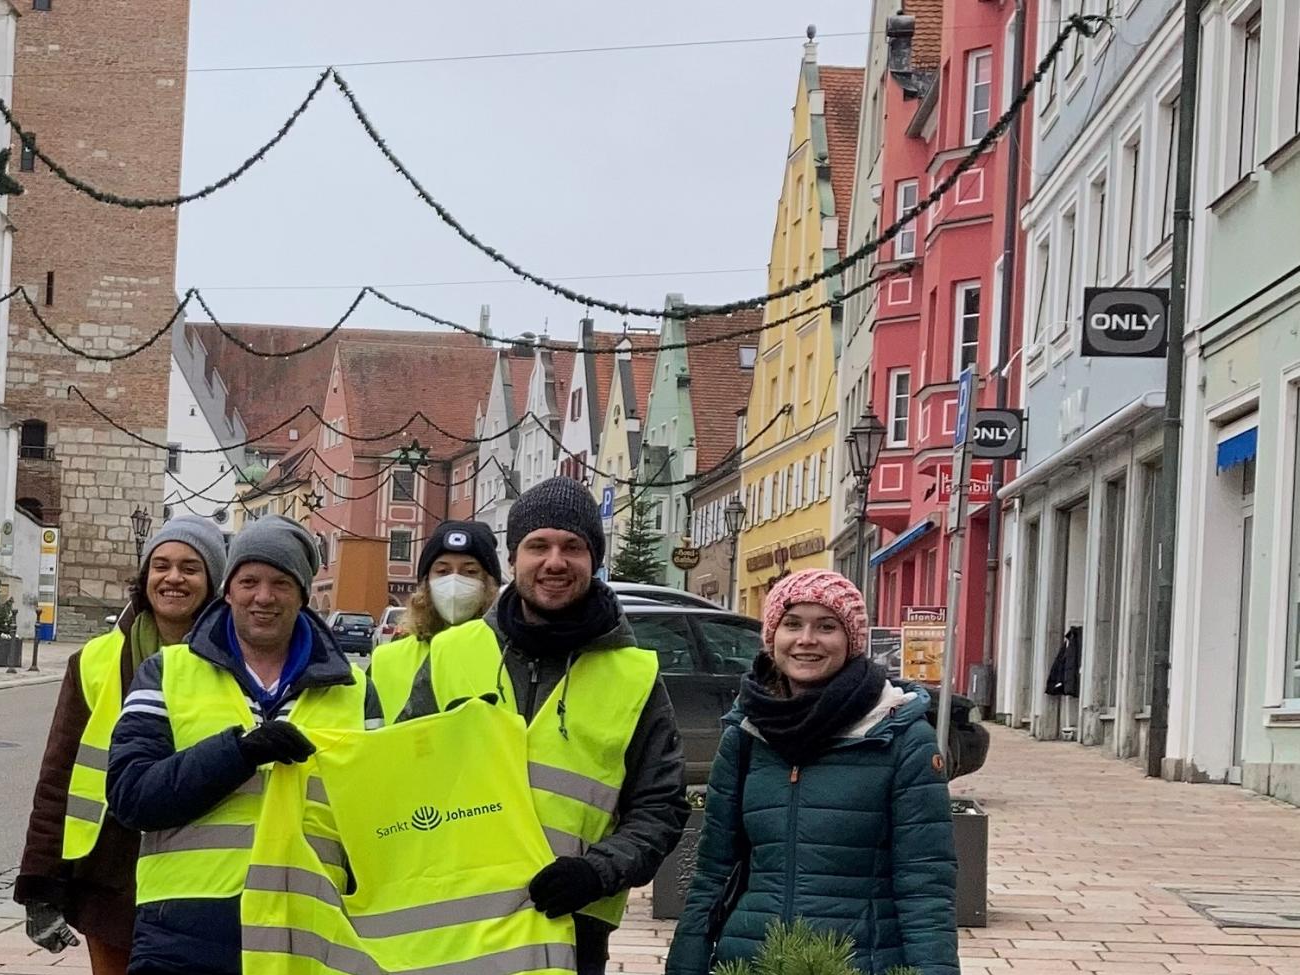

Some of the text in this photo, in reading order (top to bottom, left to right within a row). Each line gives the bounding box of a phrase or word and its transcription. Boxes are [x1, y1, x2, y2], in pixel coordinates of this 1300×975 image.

[1090, 313, 1161, 331] ONLY
[376, 801, 503, 839] Sankt Johannes
